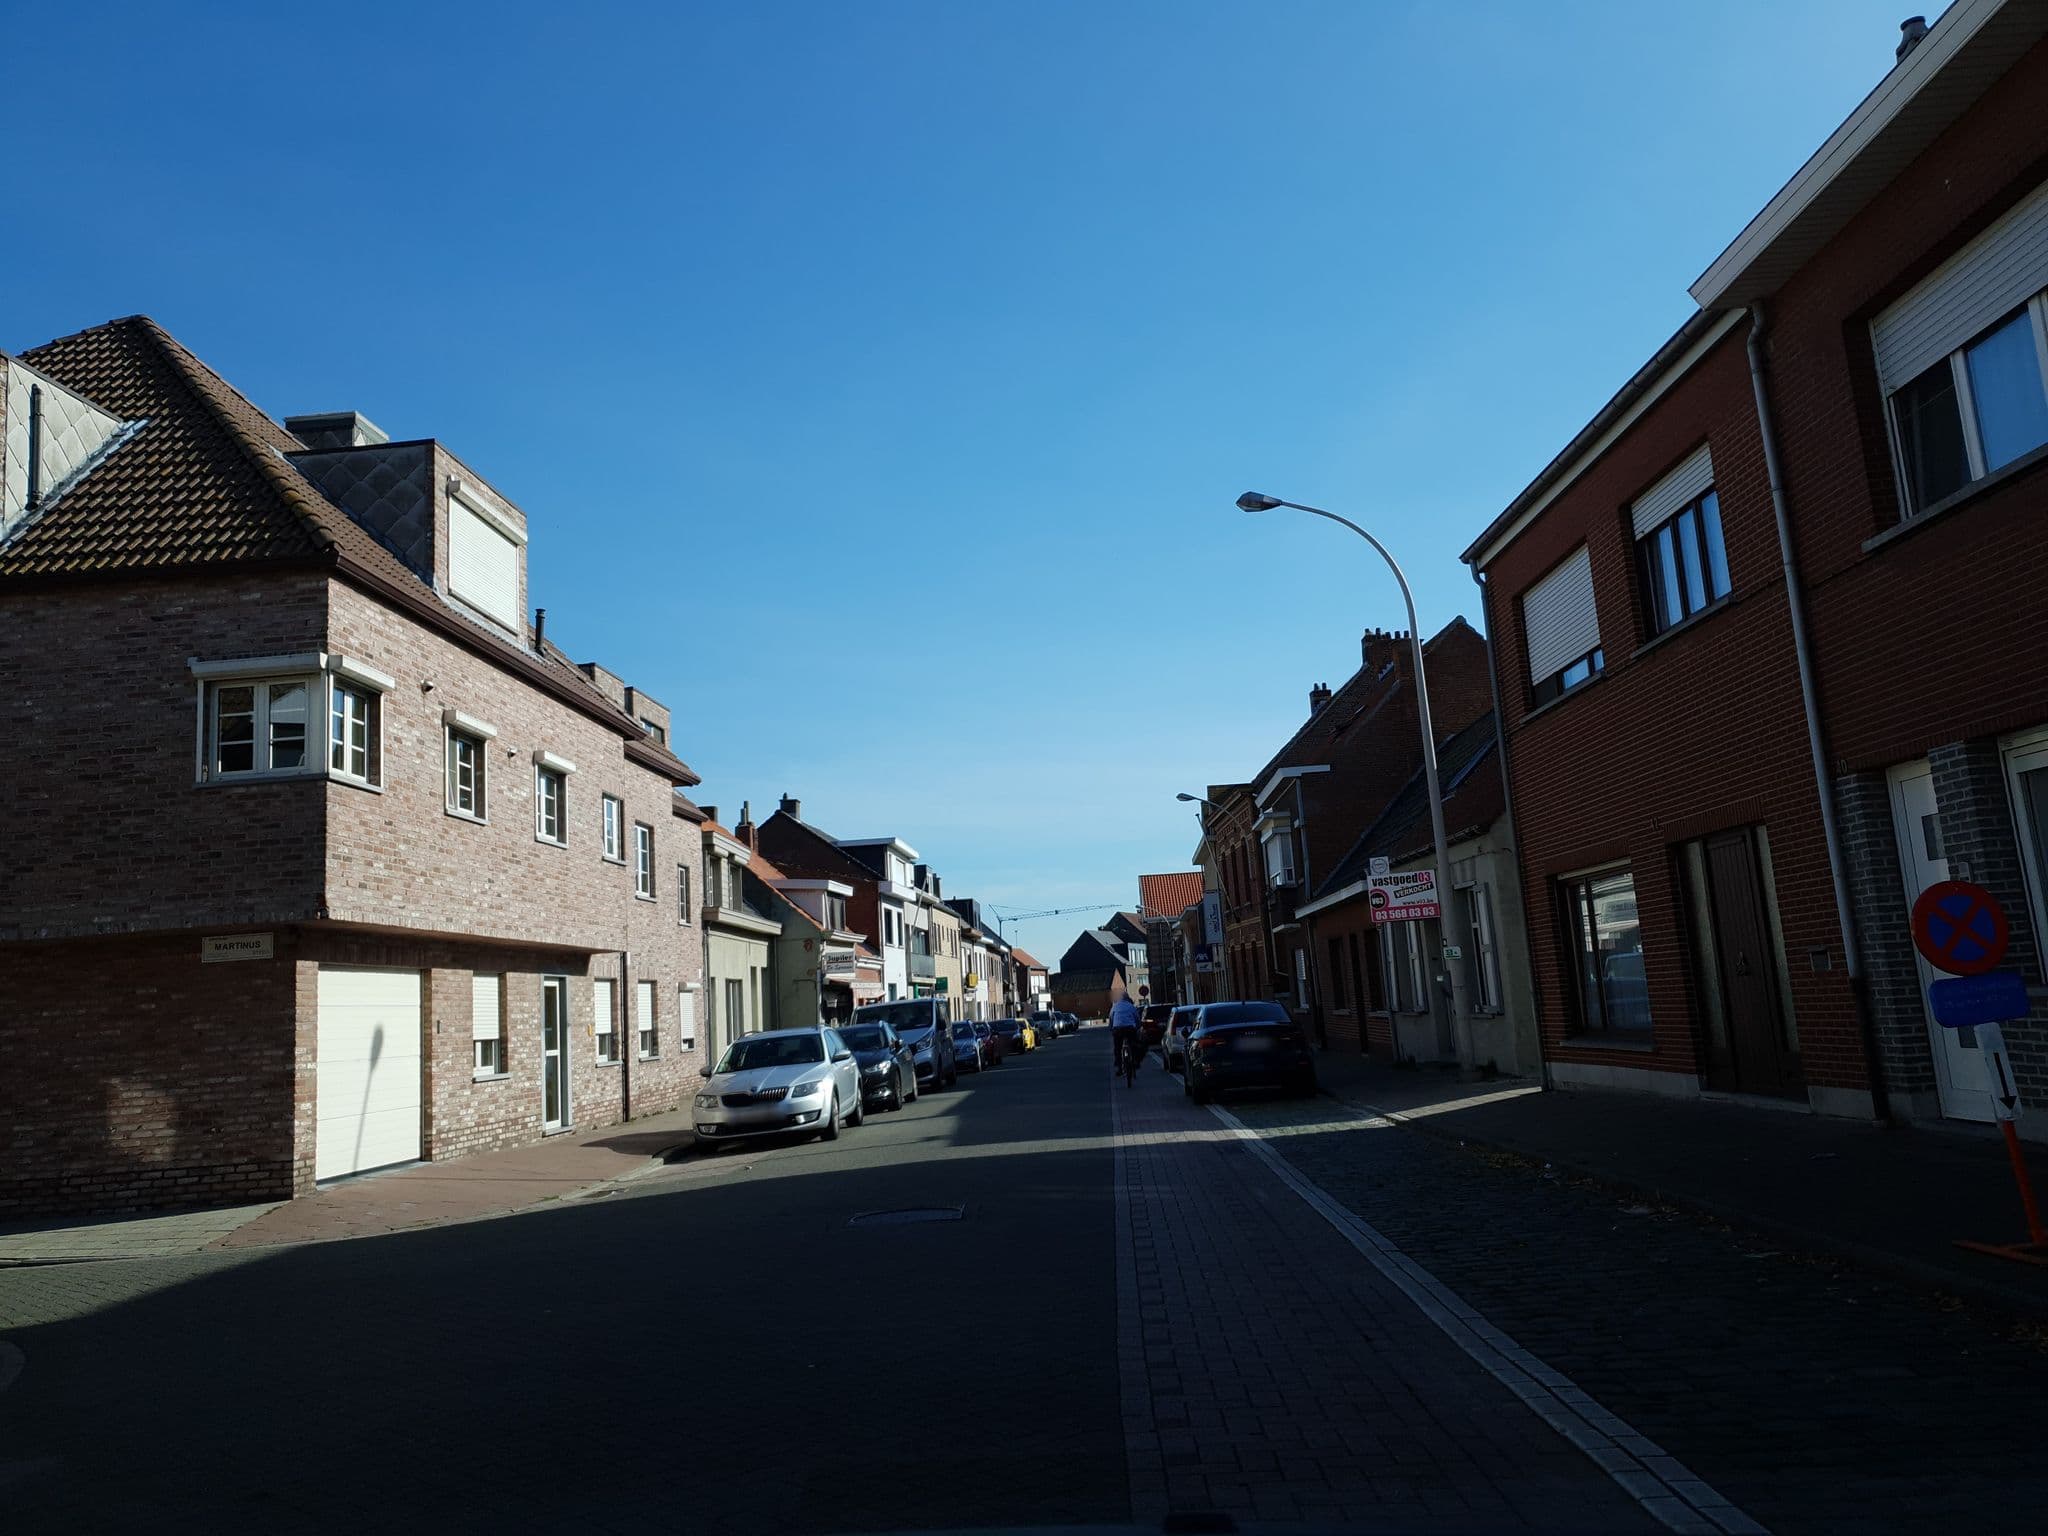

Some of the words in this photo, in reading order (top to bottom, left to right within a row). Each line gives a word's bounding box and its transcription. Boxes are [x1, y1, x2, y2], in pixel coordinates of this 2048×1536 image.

[1372, 872, 1431, 887] vastgoed03
[1395, 883, 1431, 898] VERKOCHT
[1375, 910, 1387, 920] 03
[1409, 907, 1421, 917] 03
[1422, 906, 1434, 916] 03
[214, 940, 261, 951] MARTINUS
